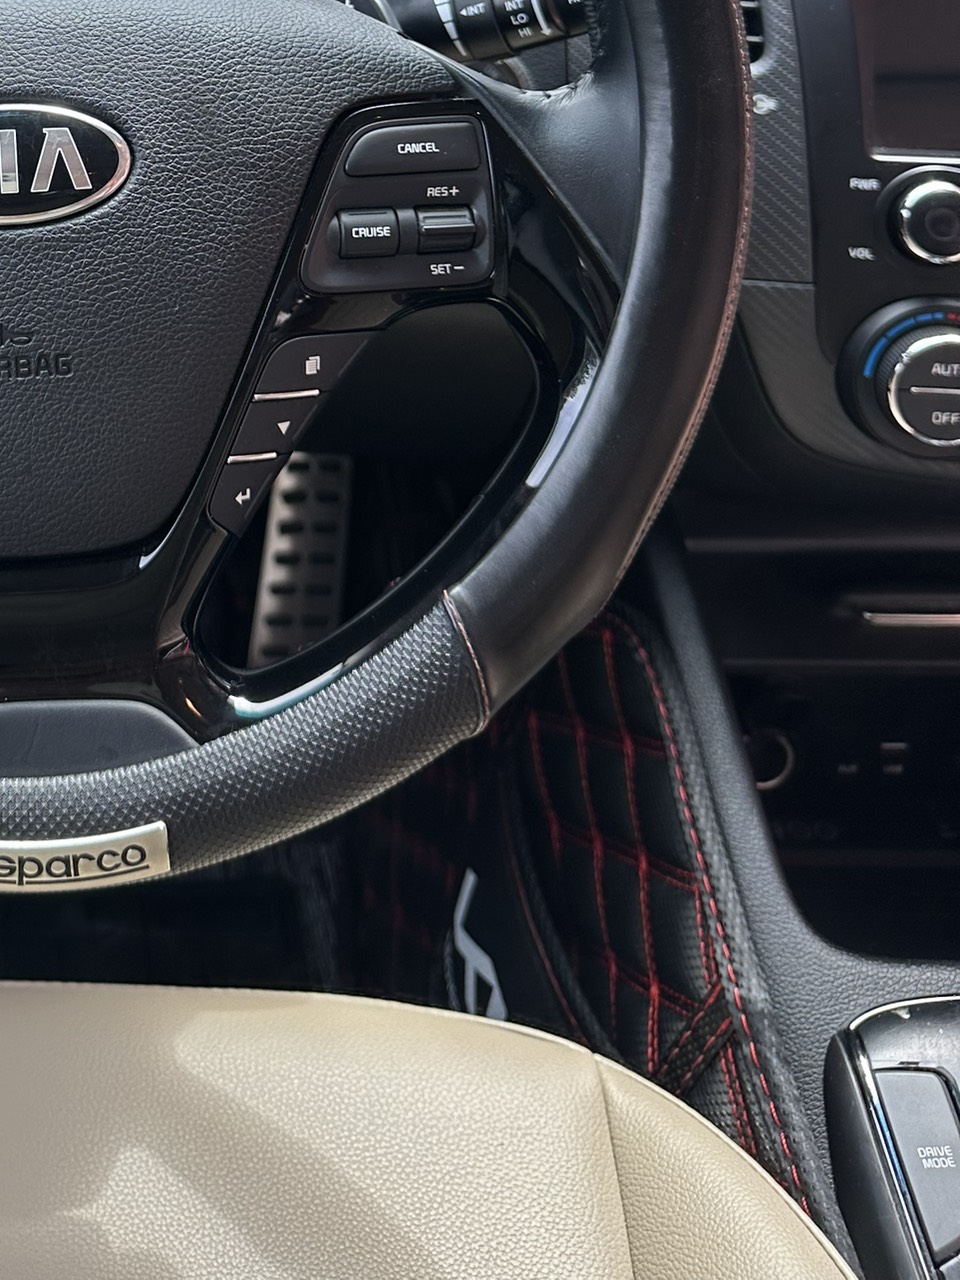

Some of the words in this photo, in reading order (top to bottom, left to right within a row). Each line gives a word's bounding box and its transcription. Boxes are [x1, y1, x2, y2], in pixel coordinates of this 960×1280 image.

[467, 2, 486, 16] INT
[510, 13, 529, 26] LO
[518, 27, 532, 38] HI
[397, 142, 440, 154] CANCEL
[351, 226, 392, 238] CRUISE
[848, 247, 876, 261] VOL
[931, 411, 960, 426] OFF
[917, 1145, 953, 1158] DRIVE
[922, 1157, 956, 1169] MODE
